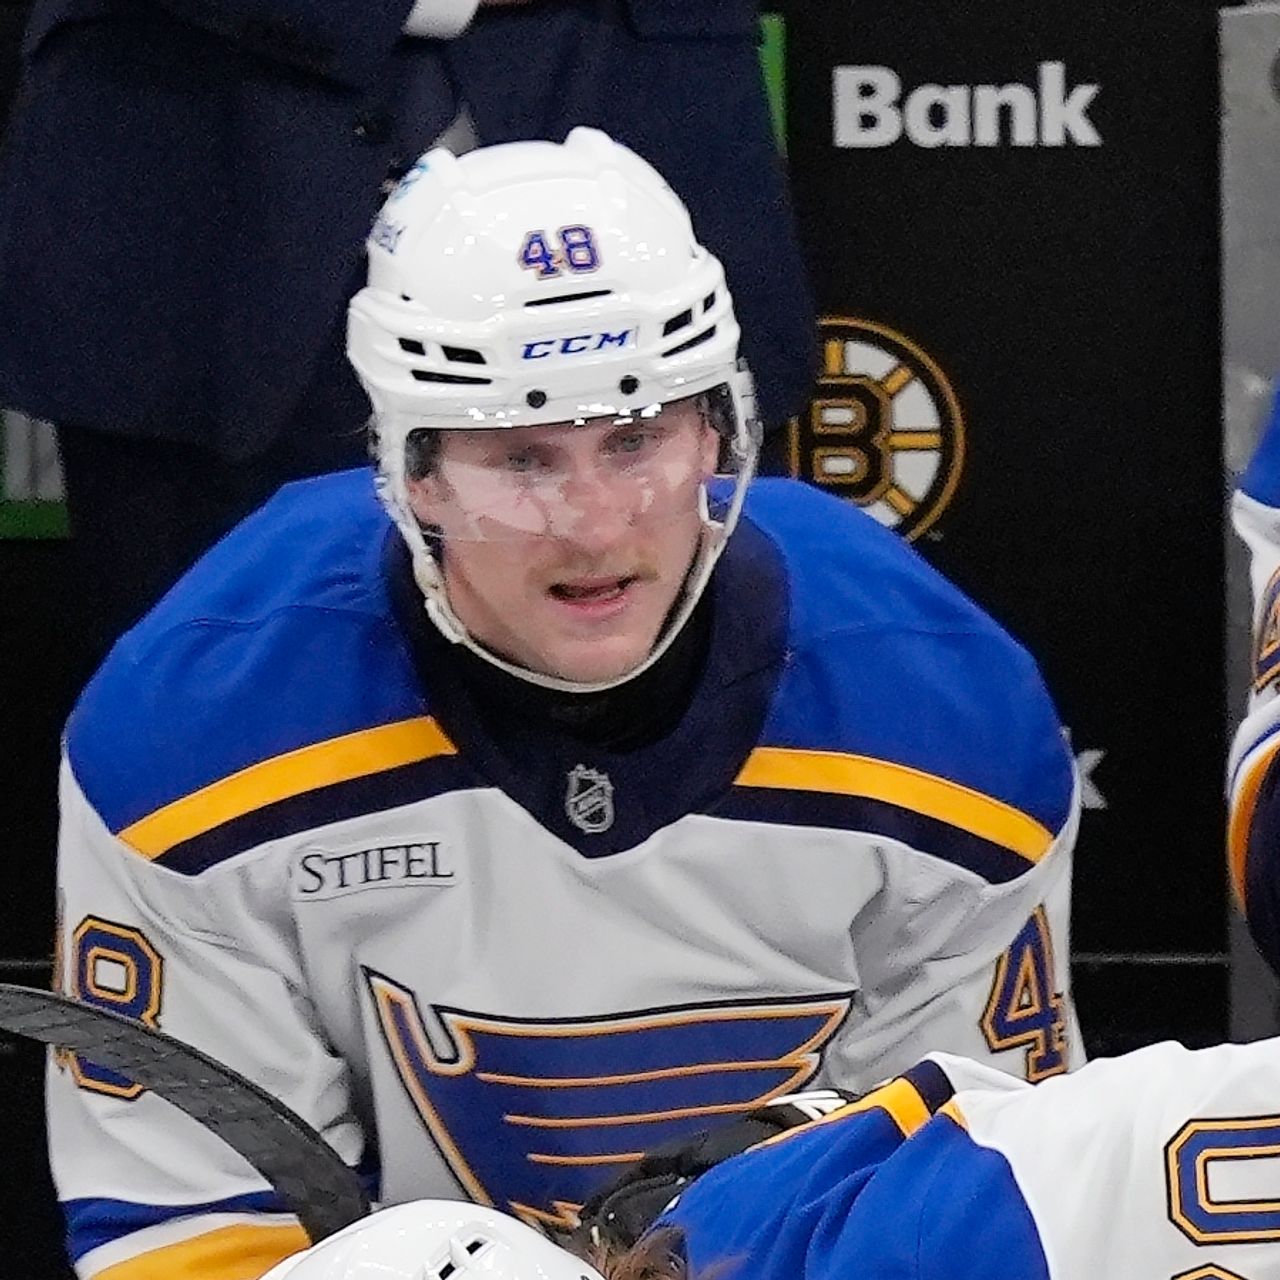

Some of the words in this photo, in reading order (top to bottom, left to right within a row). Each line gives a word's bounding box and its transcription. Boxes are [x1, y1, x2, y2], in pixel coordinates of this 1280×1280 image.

[832, 60, 1101, 148] Bank
[517, 223, 602, 281] 48
[521, 329, 634, 360] CCM
[299, 841, 454, 893] STIFEL
